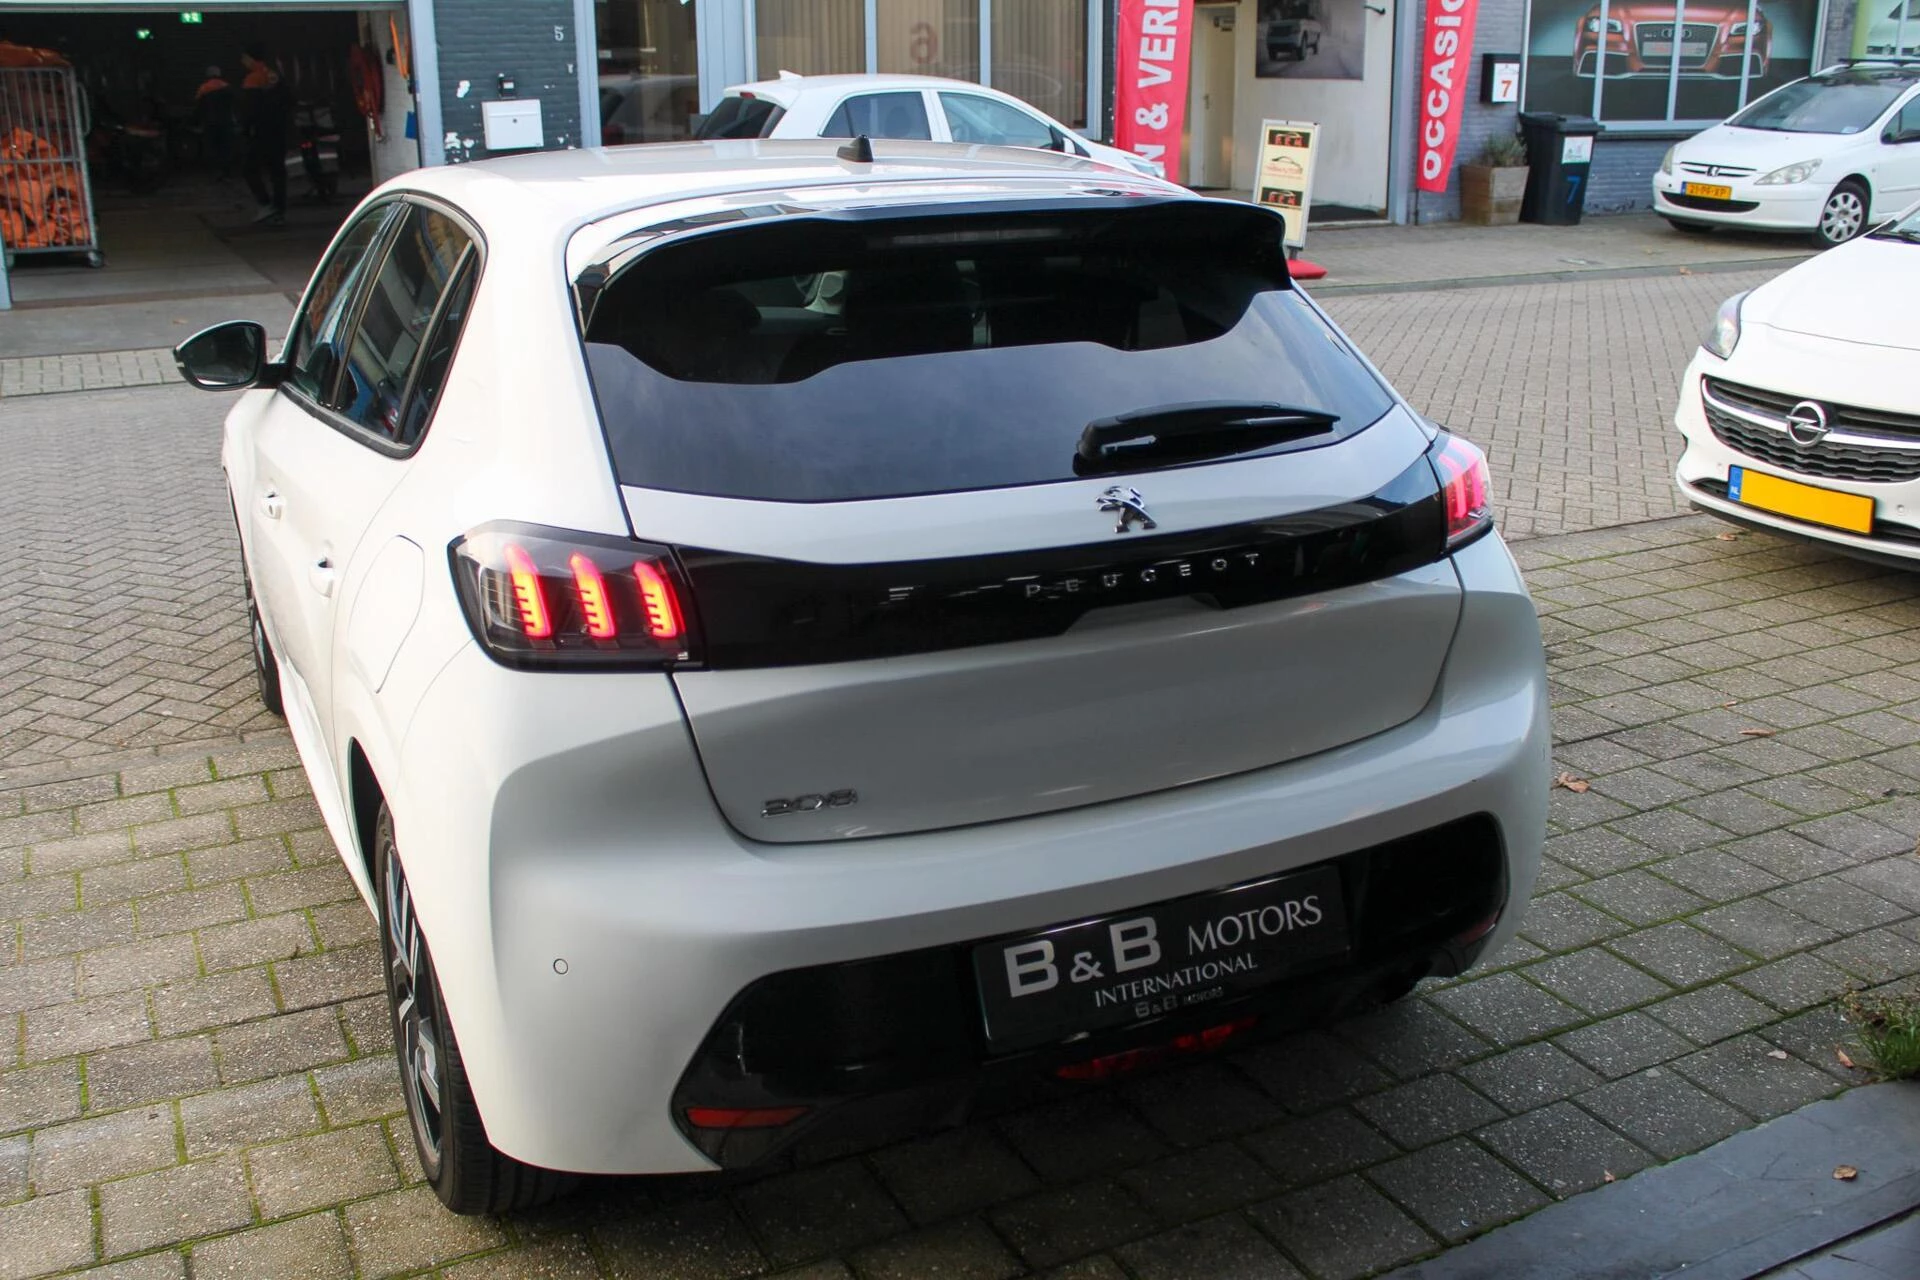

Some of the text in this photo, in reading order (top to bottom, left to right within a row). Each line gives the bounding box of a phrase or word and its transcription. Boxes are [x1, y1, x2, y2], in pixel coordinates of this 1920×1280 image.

[554, 25, 564, 41] 5
[1137, 0, 1181, 88] VER
[1501, 80, 1513, 98] 7
[1136, 102, 1169, 130] &
[1567, 176, 1581, 204] 7
[1026, 552, 1259, 598] PEUGEOT
[760, 788, 858, 819] 208
[1186, 895, 1323, 955] MOTORS
[1094, 952, 1259, 1007] INTERNATIONAL
